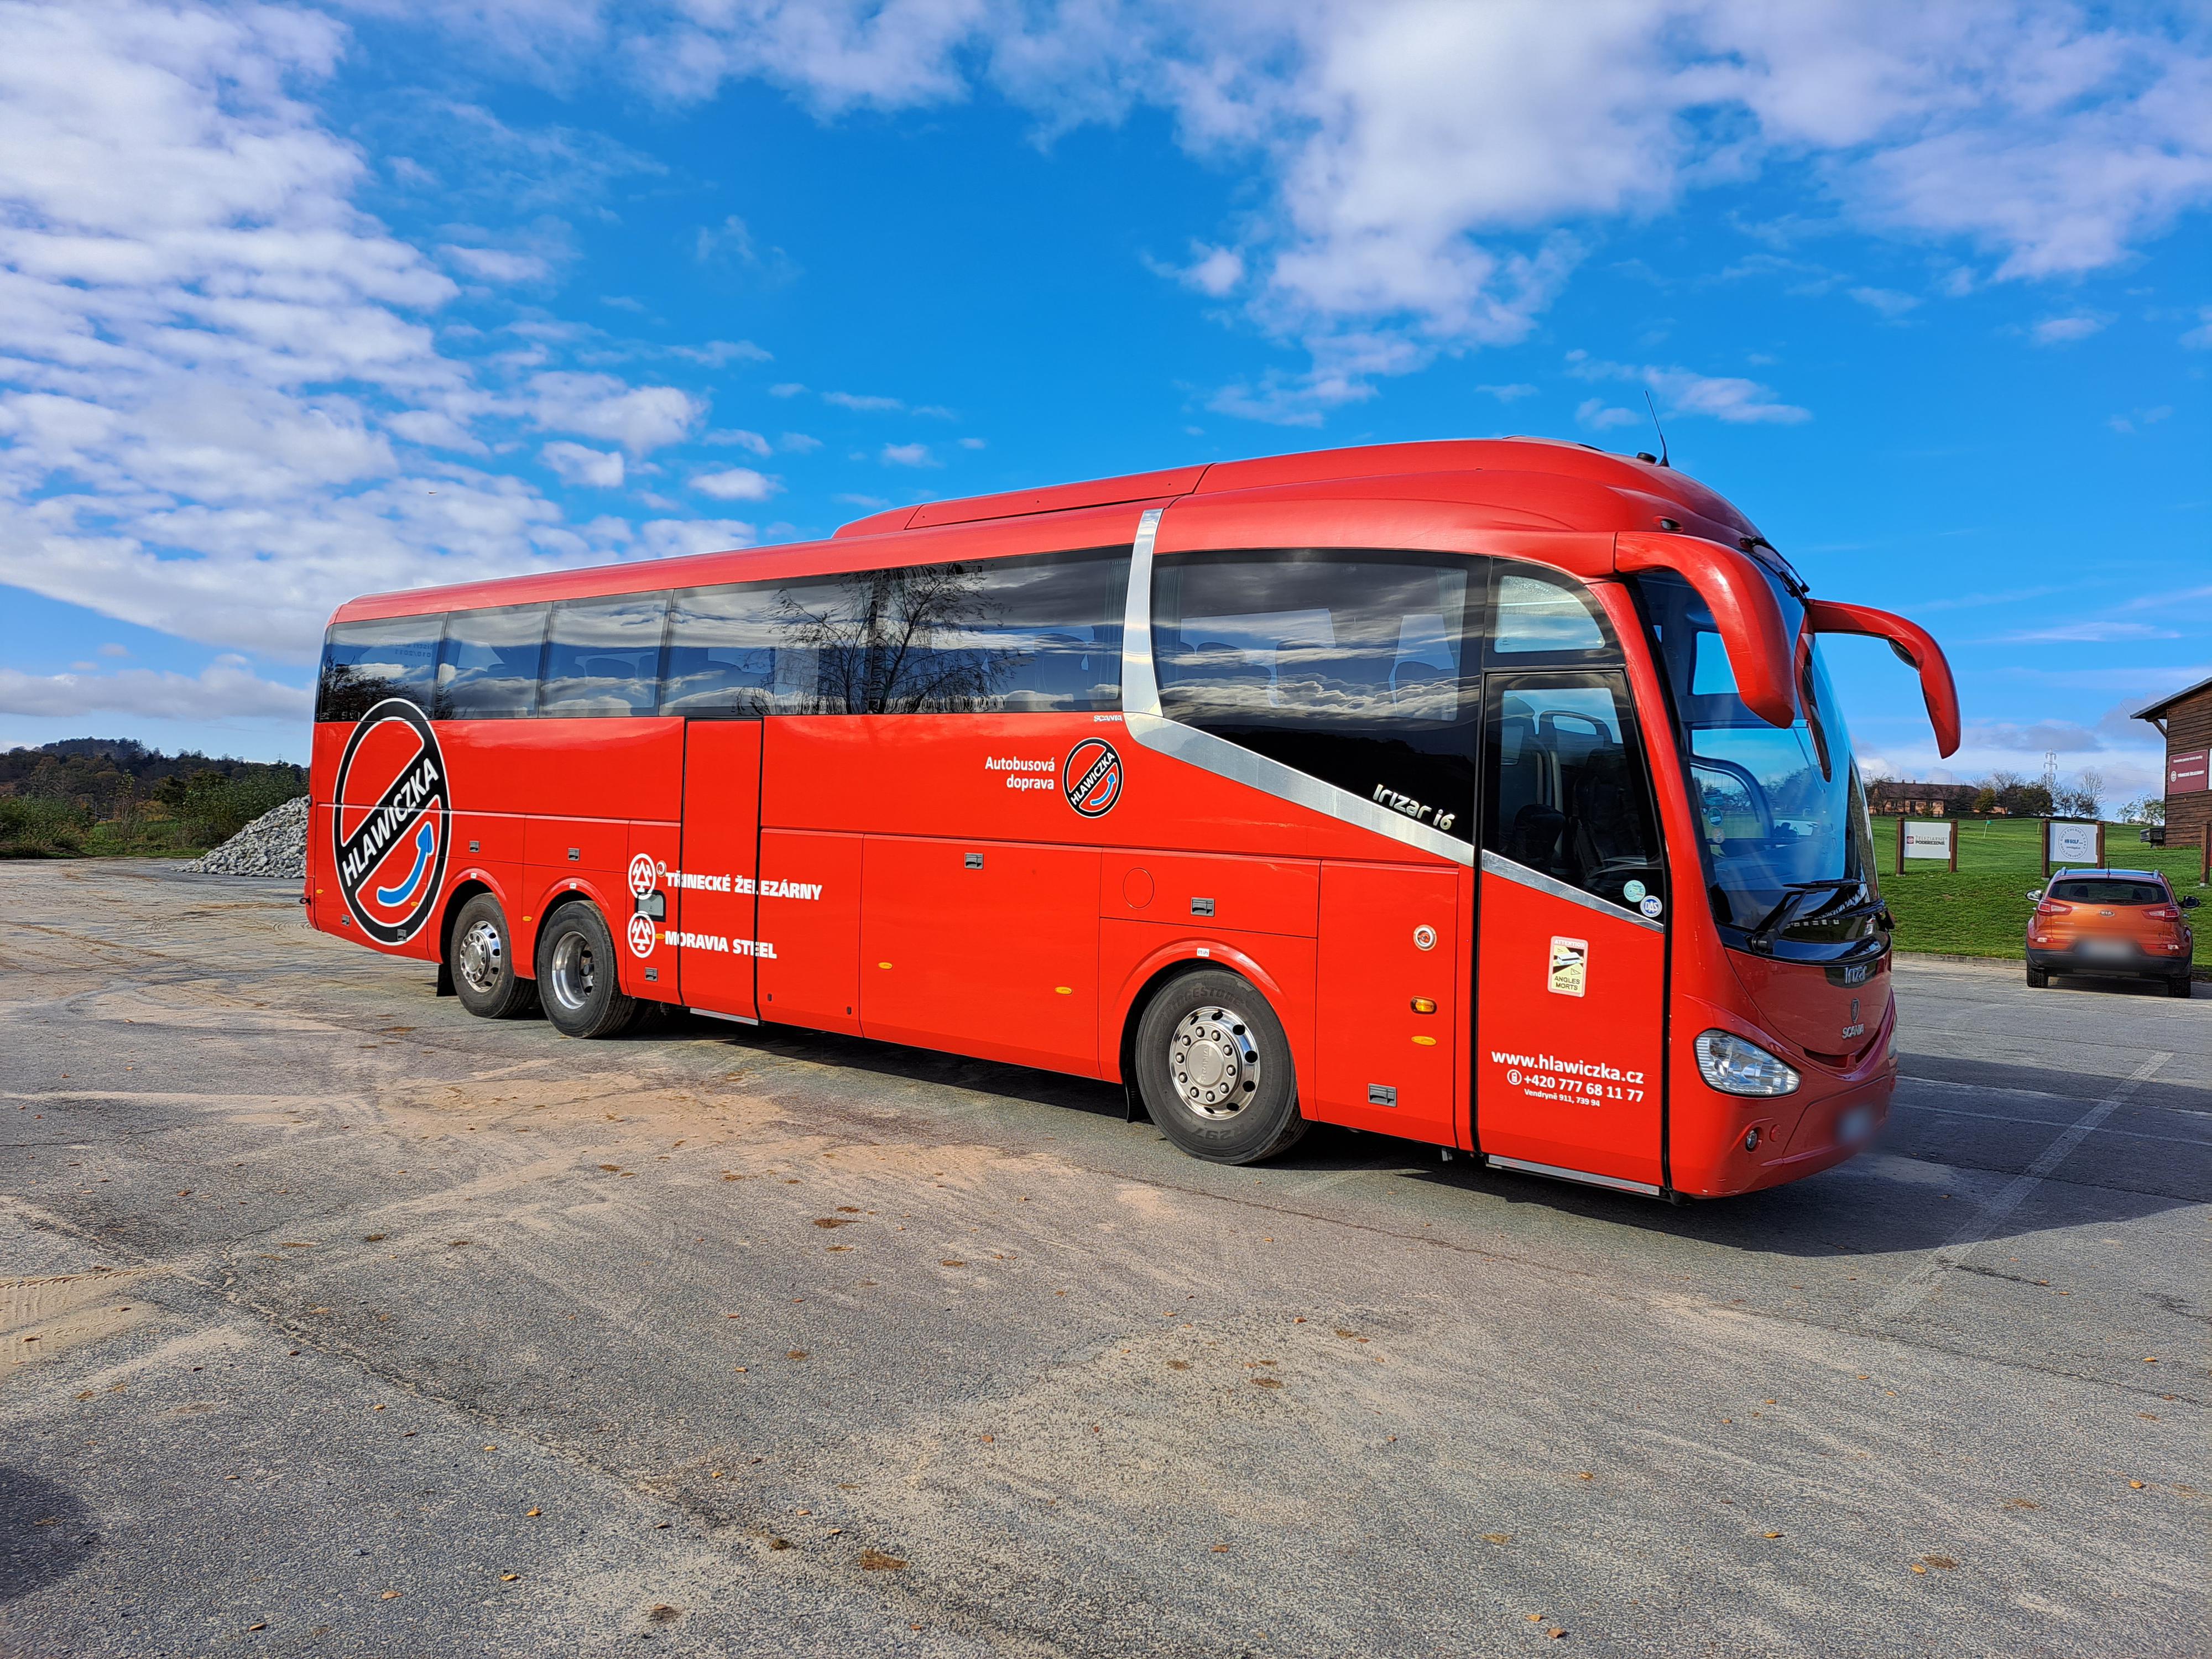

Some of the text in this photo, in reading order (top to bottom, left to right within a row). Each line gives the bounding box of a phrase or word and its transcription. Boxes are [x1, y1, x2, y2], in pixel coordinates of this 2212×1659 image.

[985, 756, 1055, 772] Autobusová
[1006, 774, 1055, 791] doprava
[1071, 752, 1115, 806] HLAWICZKA
[341, 758, 440, 887] HLAWICZKA
[1433, 809, 1456, 830] i6
[665, 870, 823, 900] TŘINECKÉ ŽELEZÁRNY
[1645, 901, 1658, 912] DAS
[665, 931, 778, 959] MORAVIA STEEL
[1554, 939, 1585, 948] ATTENTION
[1554, 975, 1580, 984] ANGLES
[1556, 982, 1578, 990] MORTS
[1159, 987, 1243, 1030] BRIDGESTONE
[1842, 1024, 1864, 1039] SCANIA
[1491, 1051, 1644, 1084] www.hlawiczka.cz
[1524, 1074, 1644, 1103] +420 777 68 11 77
[1524, 1088, 1600, 1107] Vendryně 911, 739 94
